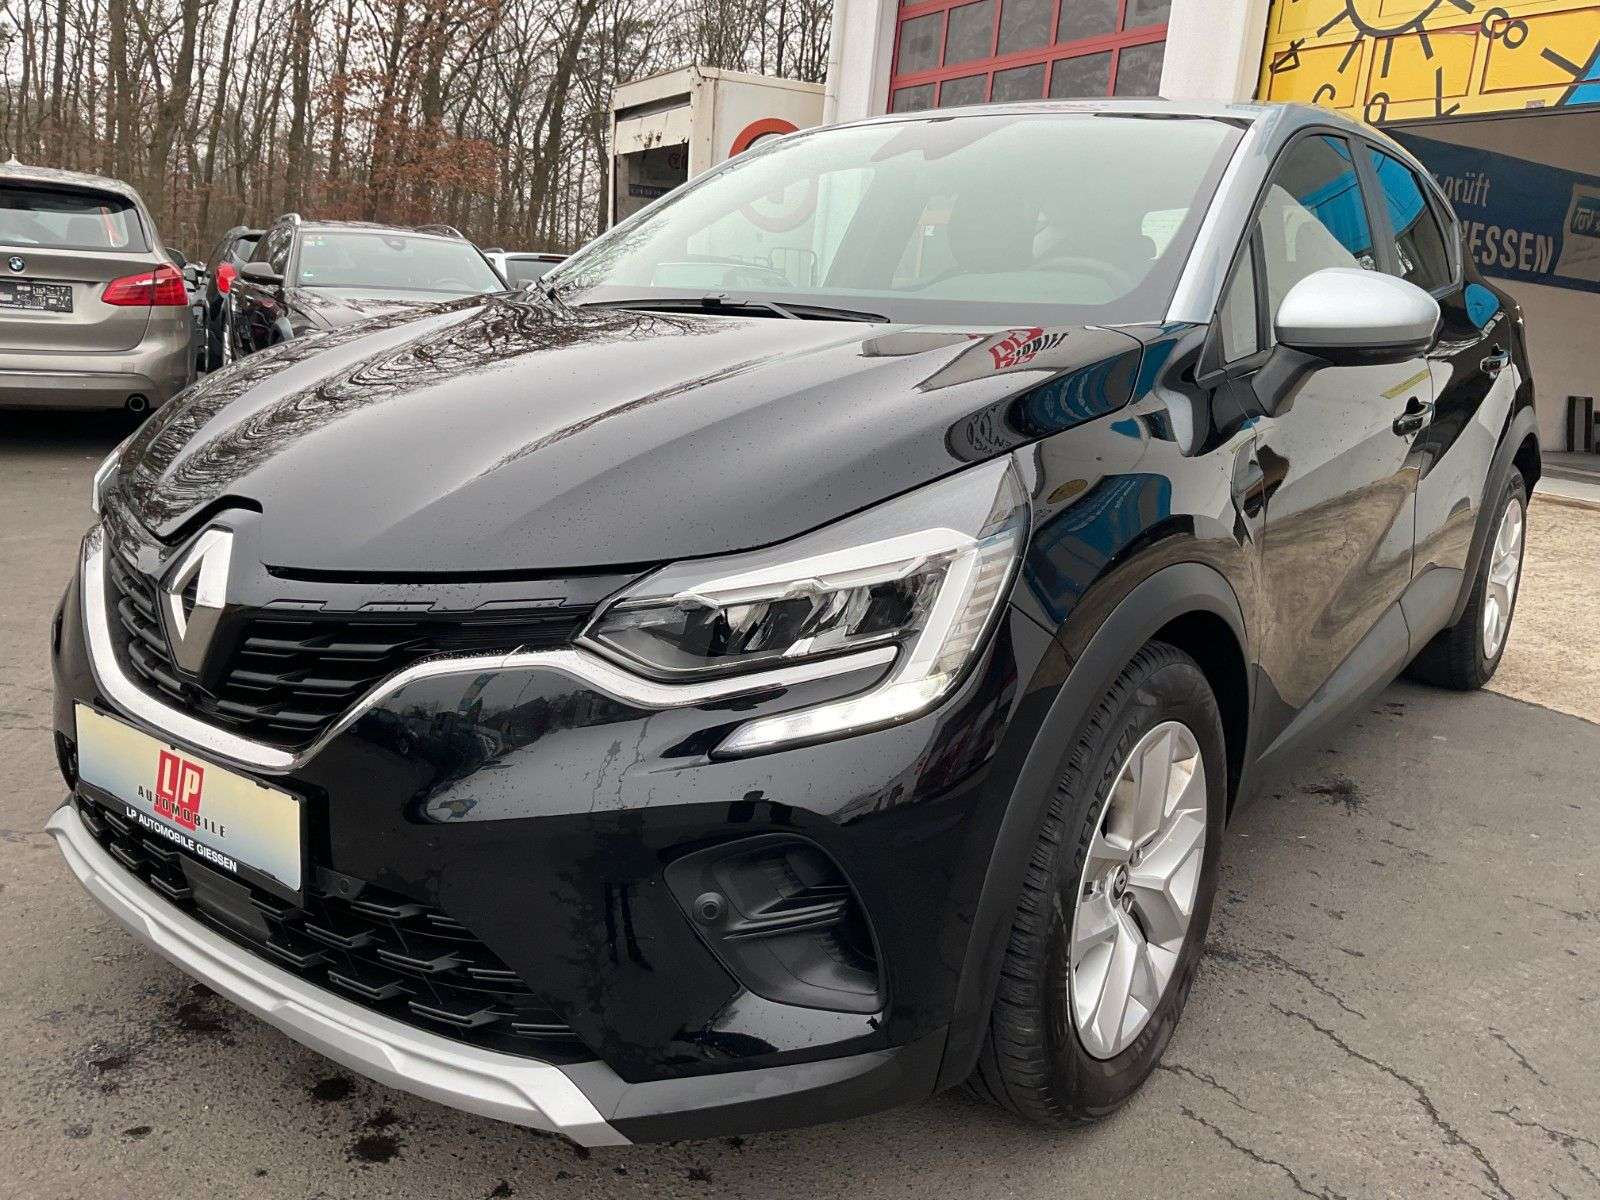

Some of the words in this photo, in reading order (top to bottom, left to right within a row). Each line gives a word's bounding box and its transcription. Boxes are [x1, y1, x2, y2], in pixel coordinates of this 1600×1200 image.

[162, 758, 200, 803] LP
[138, 785, 225, 837] AUTOMOBILE
[126, 806, 137, 819] LP
[139, 813, 195, 850] AUTOMOBILE
[196, 844, 237, 872] GIESSEN
